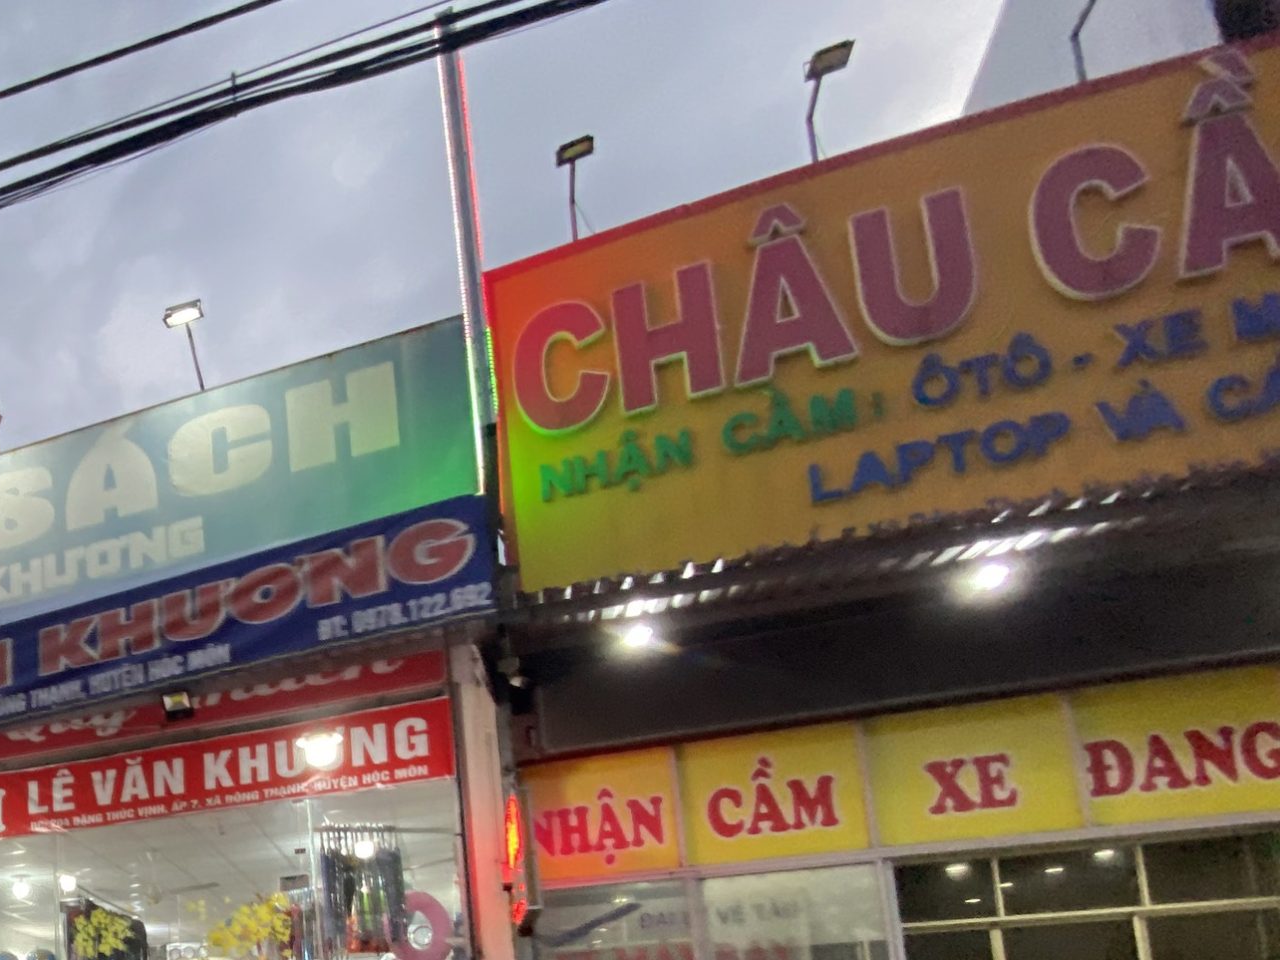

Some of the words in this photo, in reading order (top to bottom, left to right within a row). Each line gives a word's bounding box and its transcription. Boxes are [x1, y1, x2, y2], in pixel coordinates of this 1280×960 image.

[511, 185, 977, 438] CHÂU
[539, 430, 694, 504] NHẬN
[911, 331, 1053, 408] ÔTÔ
[1112, 307, 1210, 368] XE
[808, 410, 1071, 502] LAPTOP
[1094, 378, 1187, 440] VÀ
[38, 517, 477, 674] KHƯƠNG
[27, 768, 76, 815] LÊ
[90, 756, 186, 806] VĂN
[202, 717, 430, 791] KHƯƠNG
[534, 787, 664, 865] NHẬN
[706, 755, 840, 838] CẦM
[924, 754, 1017, 814] XE
[1083, 721, 1280, 798] ĐANG
